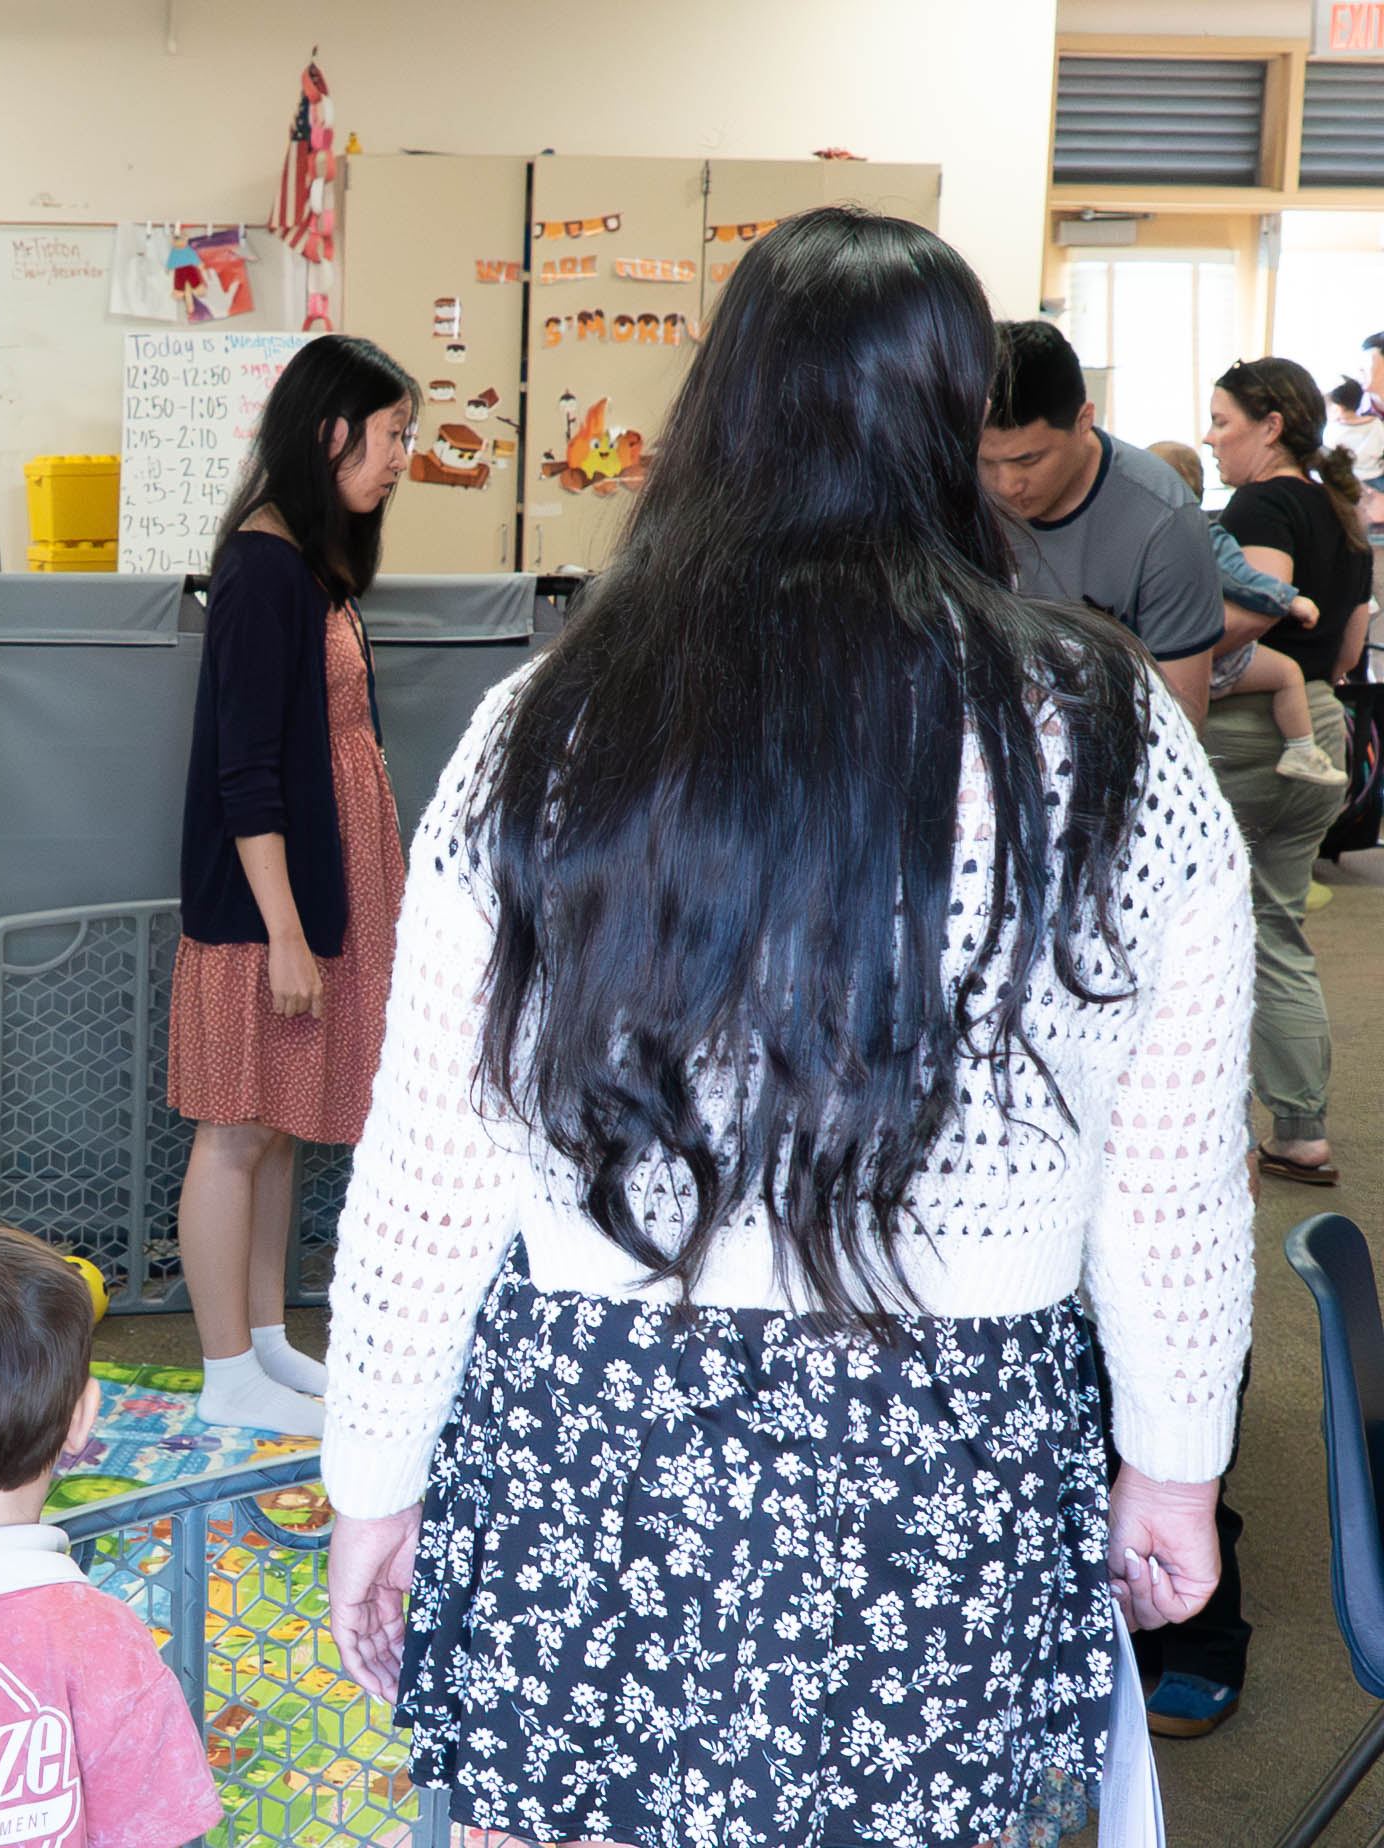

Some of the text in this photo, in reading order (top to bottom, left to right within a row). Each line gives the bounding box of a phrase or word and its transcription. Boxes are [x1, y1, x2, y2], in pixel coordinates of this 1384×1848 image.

[1329, 3, 1384, 49] EXIT
[475, 259, 521, 282] WE
[541, 255, 598, 284] ARE
[129, 335, 193, 362] Today
